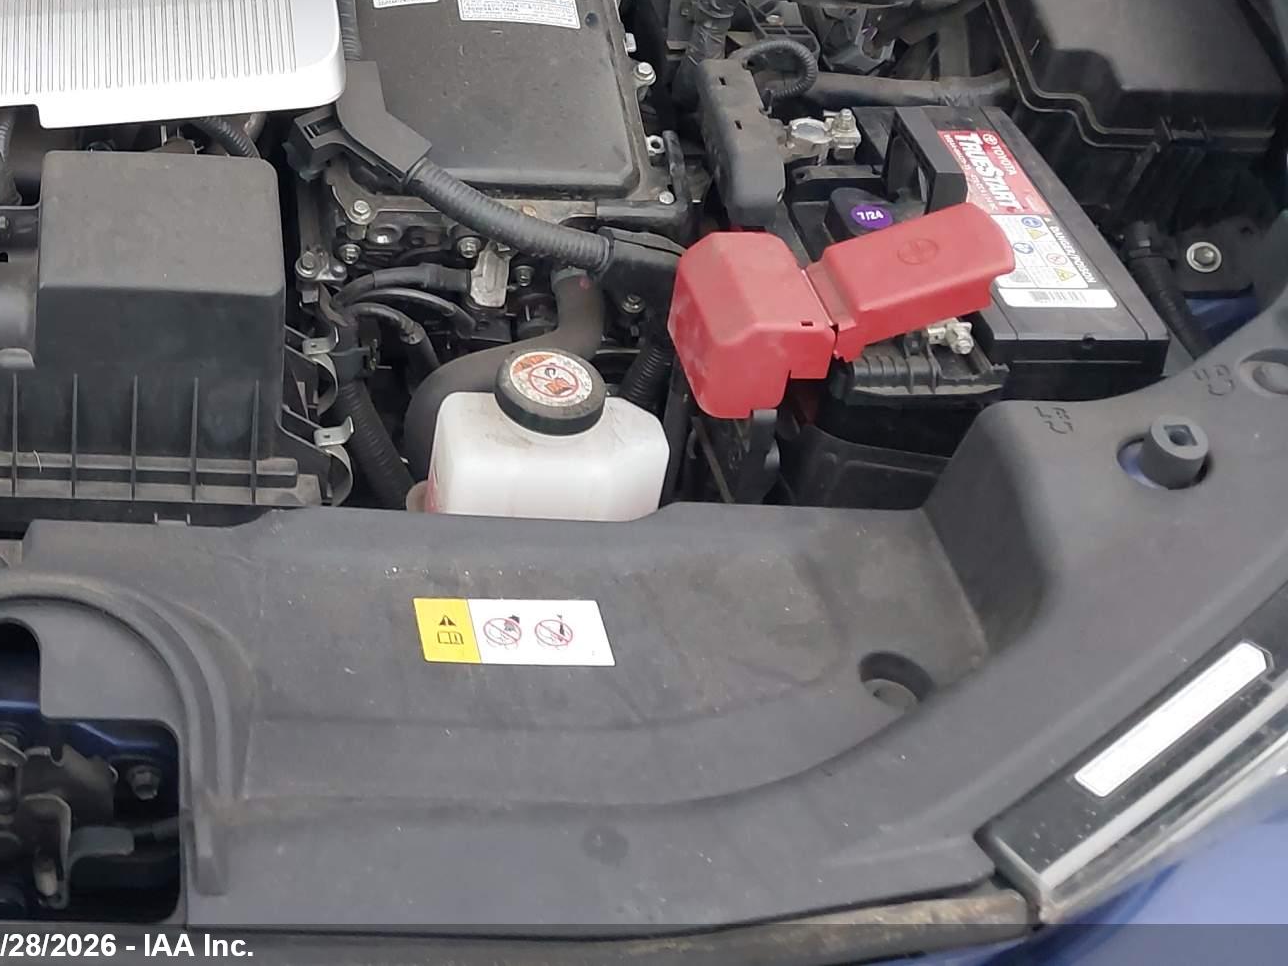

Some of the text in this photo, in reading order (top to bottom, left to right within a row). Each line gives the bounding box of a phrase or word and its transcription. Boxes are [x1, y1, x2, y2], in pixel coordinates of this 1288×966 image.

[991, 145, 1017, 175] TOYOTA
[856, 209, 884, 221] 7/24
[1049, 225, 1097, 283] DANGER/POISON
